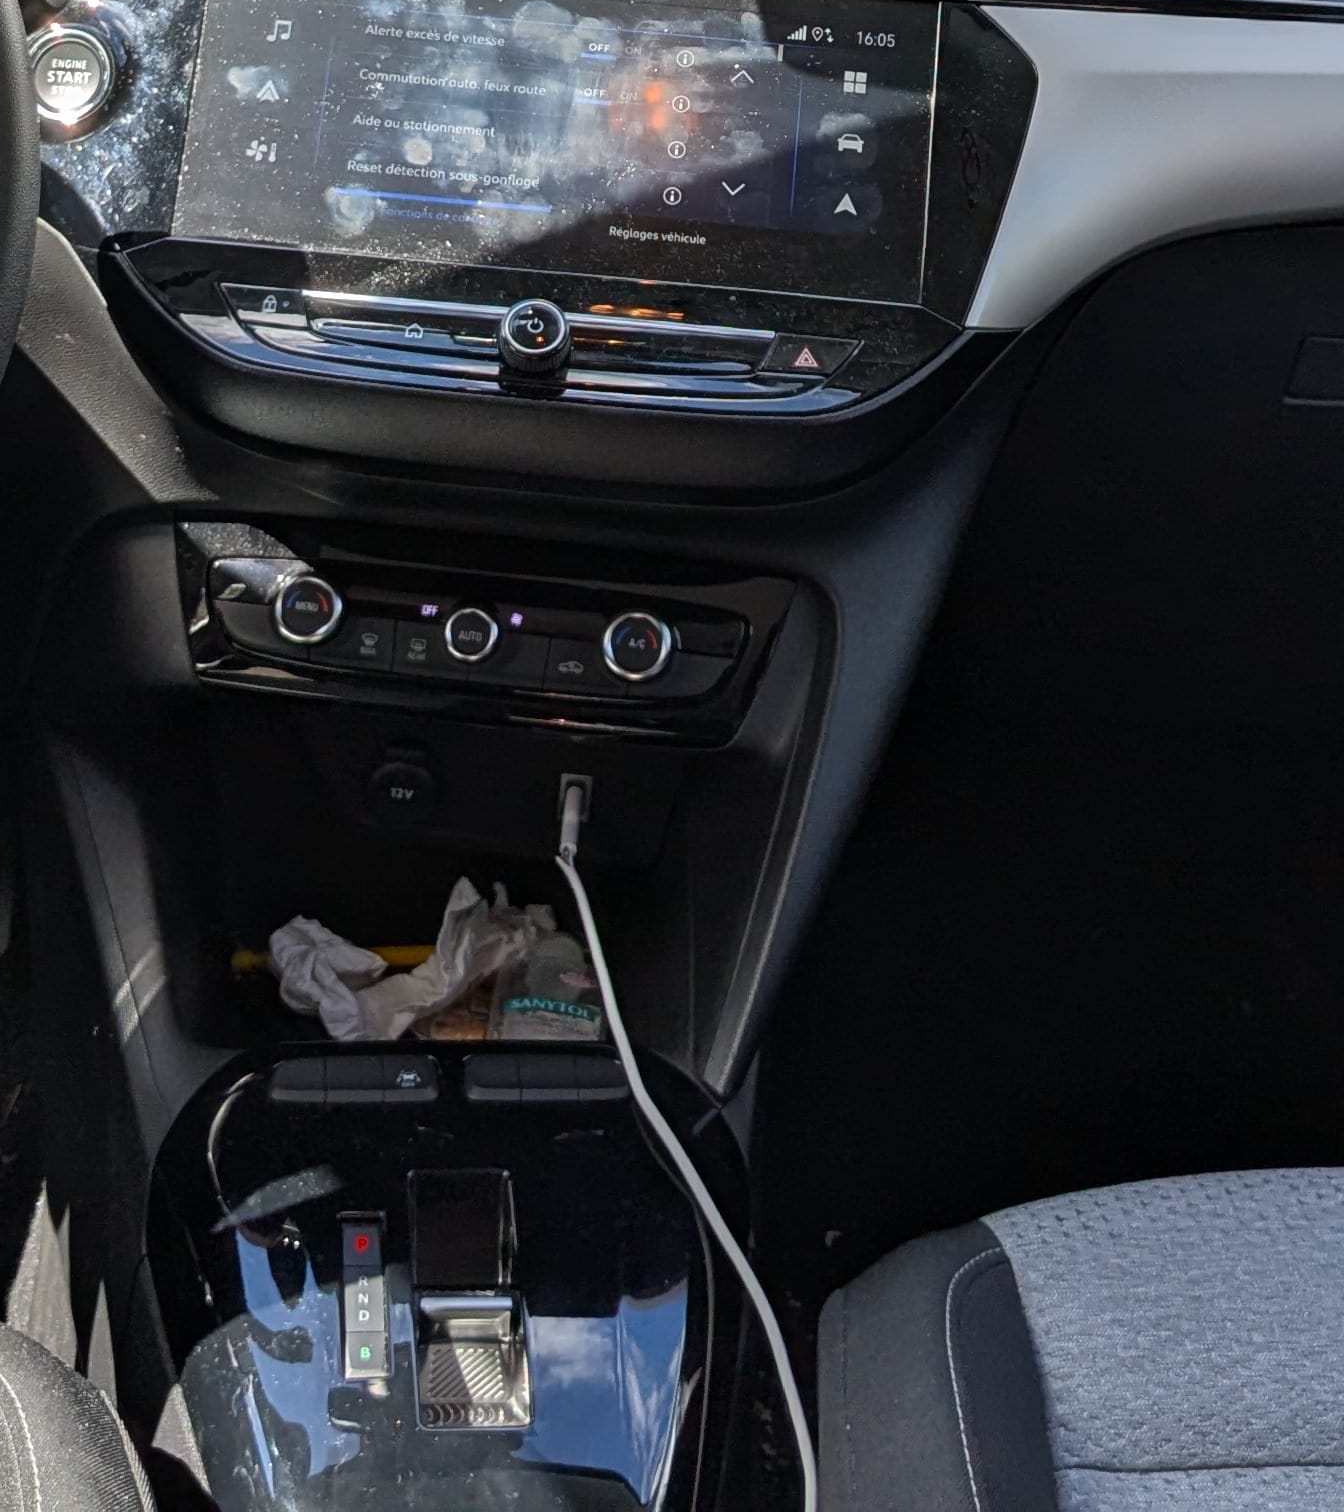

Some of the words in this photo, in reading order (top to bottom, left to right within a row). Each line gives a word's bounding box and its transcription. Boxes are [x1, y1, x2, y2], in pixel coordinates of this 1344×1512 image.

[364, 23, 404, 39] Alerte
[443, 30, 460, 43] de
[462, 34, 506, 47] vitesse
[855, 31, 896, 48] 16:05
[588, 42, 611, 53] OFF
[624, 46, 642, 56] ON
[51, 58, 88, 69] ENGINE
[47, 70, 92, 85] START
[359, 68, 446, 86] Commutation
[483, 78, 511, 93] feux
[512, 82, 547, 97] route
[583, 87, 606, 98] OFF
[352, 113, 382, 127] Aide
[383, 118, 400, 129] au
[403, 118, 496, 138] stationnement
[347, 159, 383, 174] Reset
[385, 162, 446, 181] détection
[448, 170, 541, 189] sous-gonflage
[436, 210, 450, 222] de
[608, 224, 659, 243] Réglages
[661, 230, 707, 246] véhicule
[421, 603, 439, 617] OFF
[458, 629, 483, 642] AUTO
[628, 637, 646, 651] A/C
[390, 786, 415, 800] 12V
[510, 997, 592, 1020] SANYTOL
[356, 1236, 368, 1250] P
[358, 1275, 369, 1287] R
[357, 1292, 369, 1306] N
[358, 1308, 370, 1322] D
[359, 1346, 371, 1361] B
